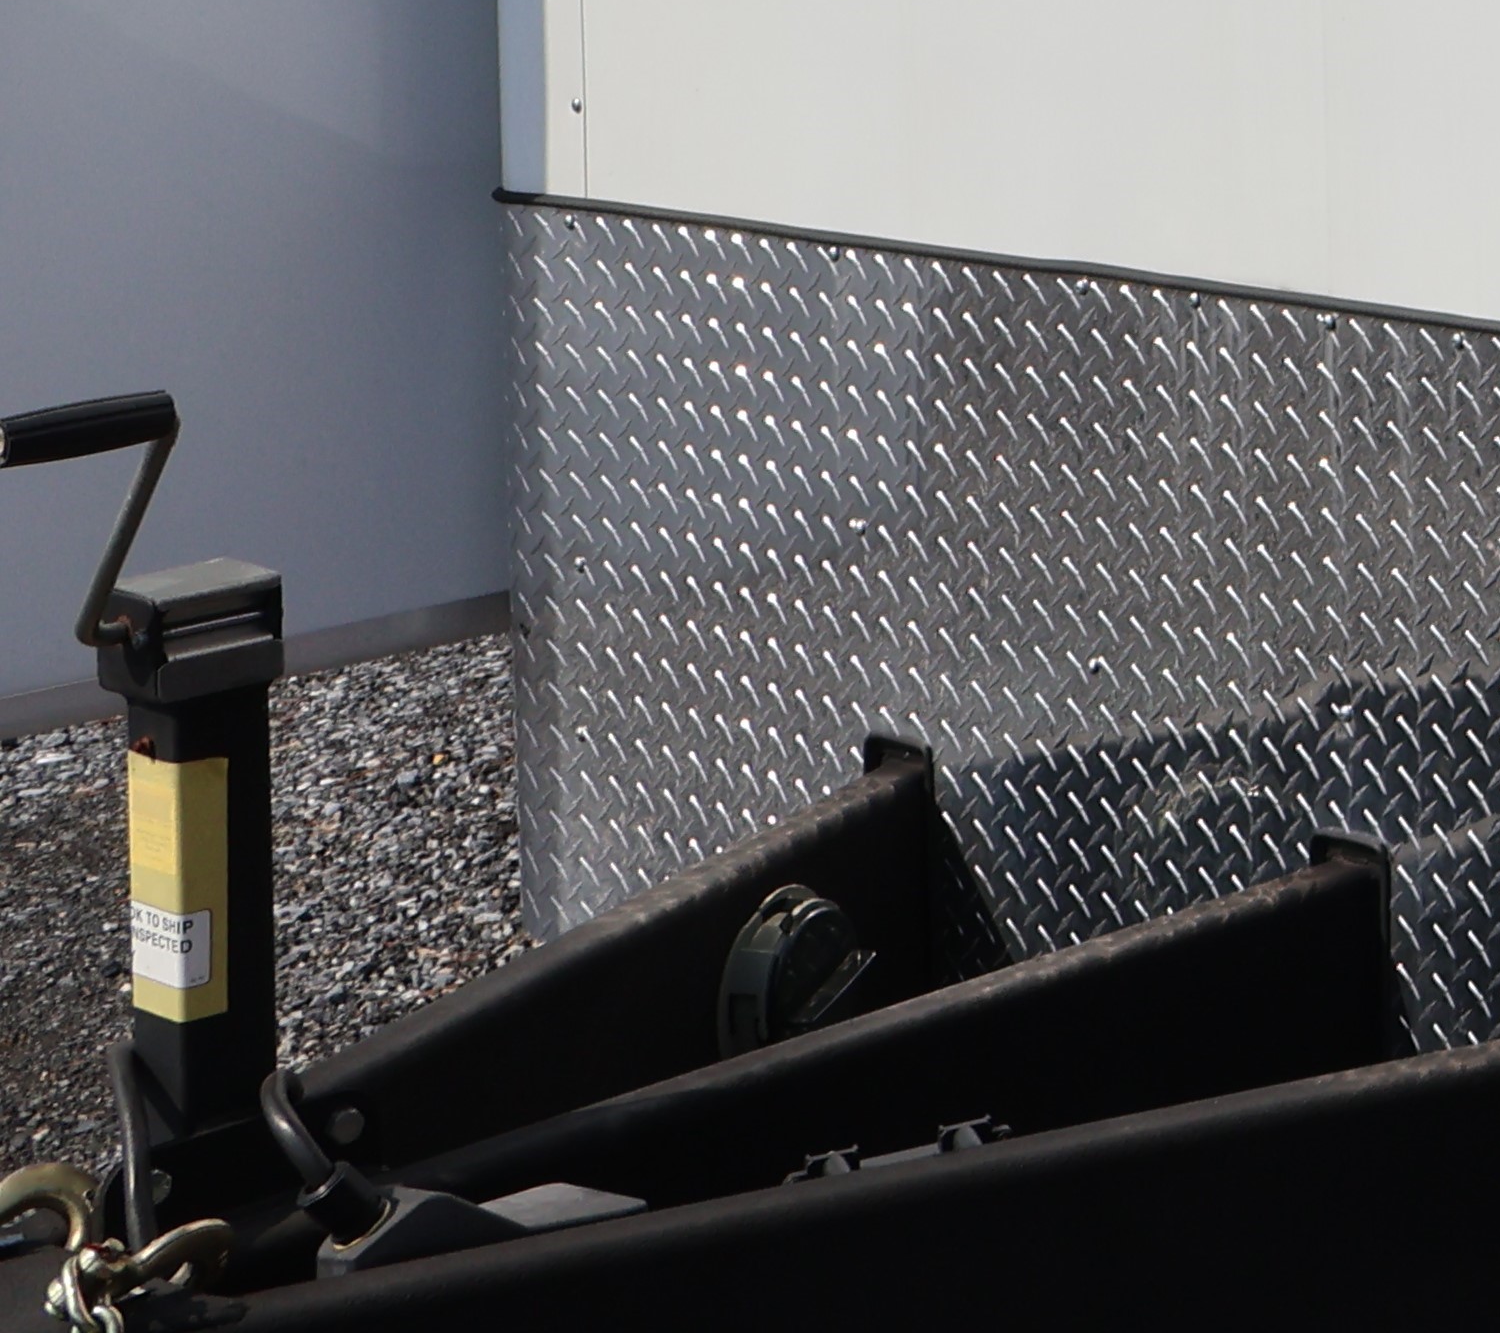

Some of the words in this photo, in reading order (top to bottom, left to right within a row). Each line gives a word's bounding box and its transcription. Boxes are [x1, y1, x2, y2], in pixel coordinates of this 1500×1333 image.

[145, 911, 160, 929] TO
[162, 917, 194, 935] SHIP
[131, 926, 194, 955] NSPECTED
